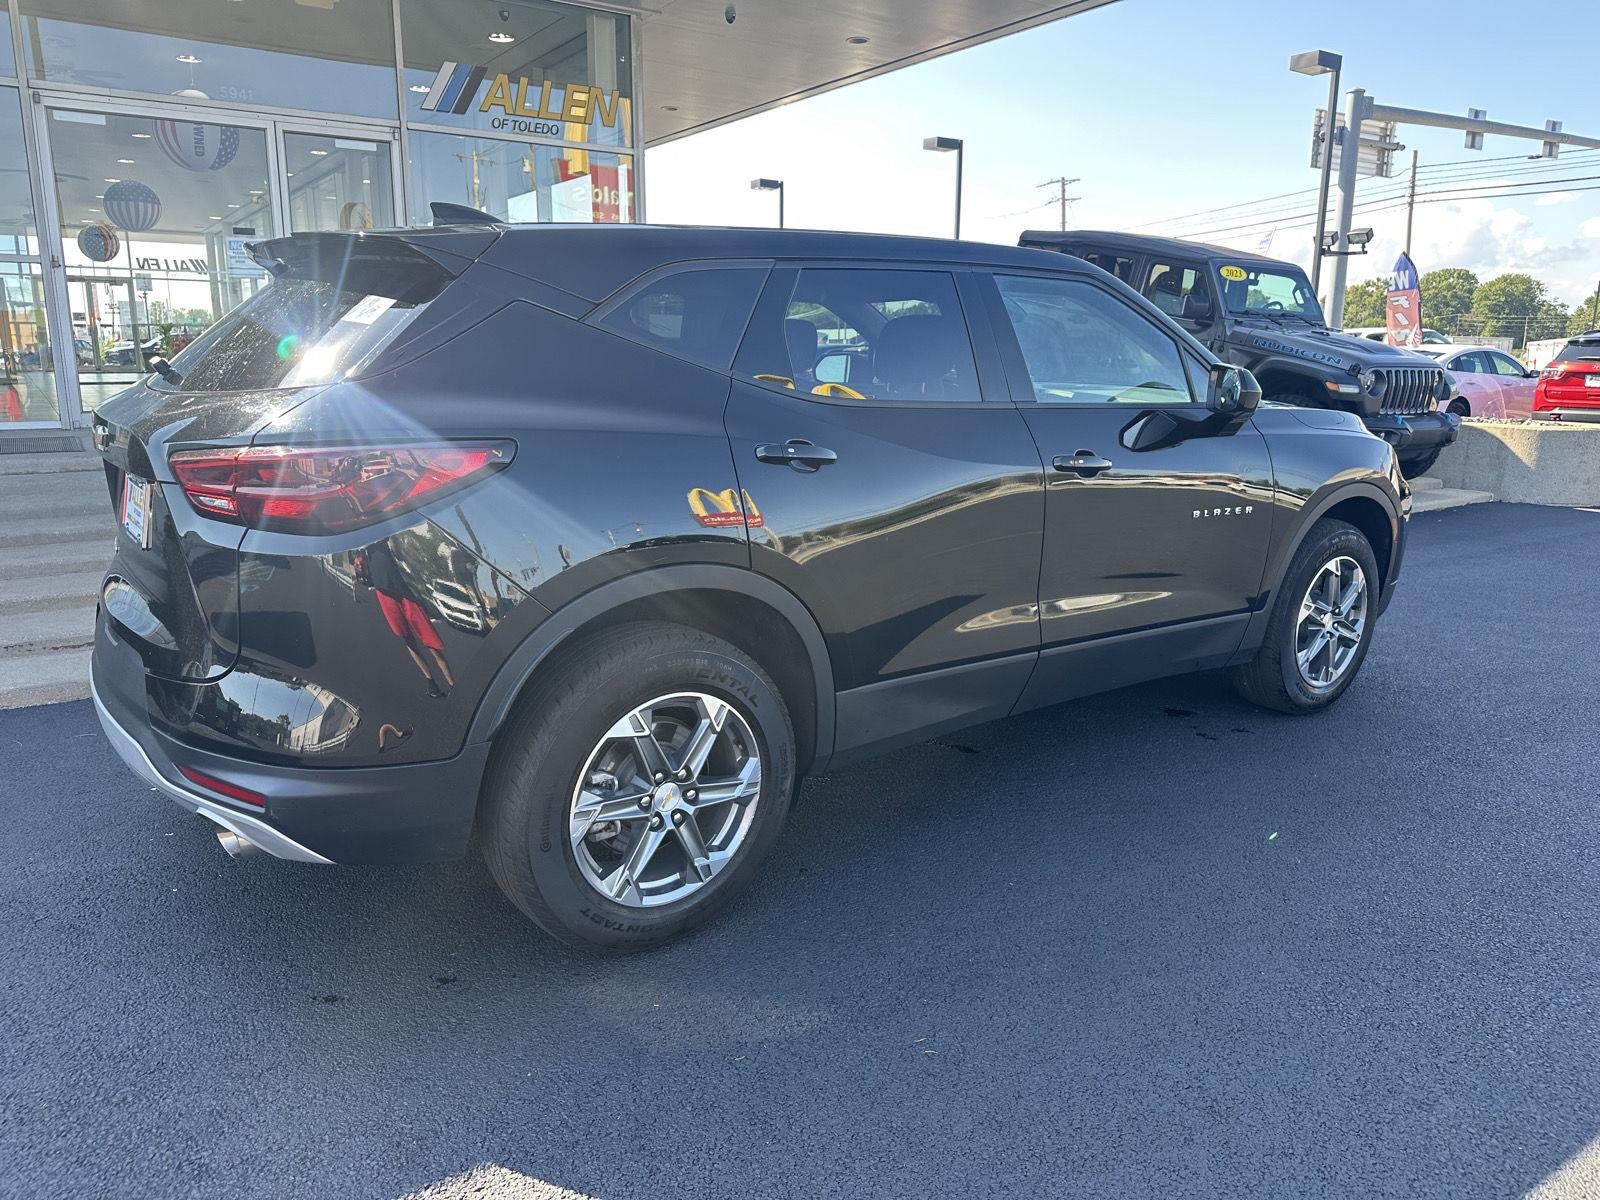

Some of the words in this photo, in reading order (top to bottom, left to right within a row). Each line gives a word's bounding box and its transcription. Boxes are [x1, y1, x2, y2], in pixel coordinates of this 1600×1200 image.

[220, 86, 253, 99] 5941
[479, 72, 620, 128] ALLEN
[491, 117, 509, 130] OF
[511, 119, 560, 136] TOLEDO
[1225, 268, 1244, 279] 2023
[1253, 337, 1342, 365] RUBICON
[1192, 505, 1253, 518] BLAZER
